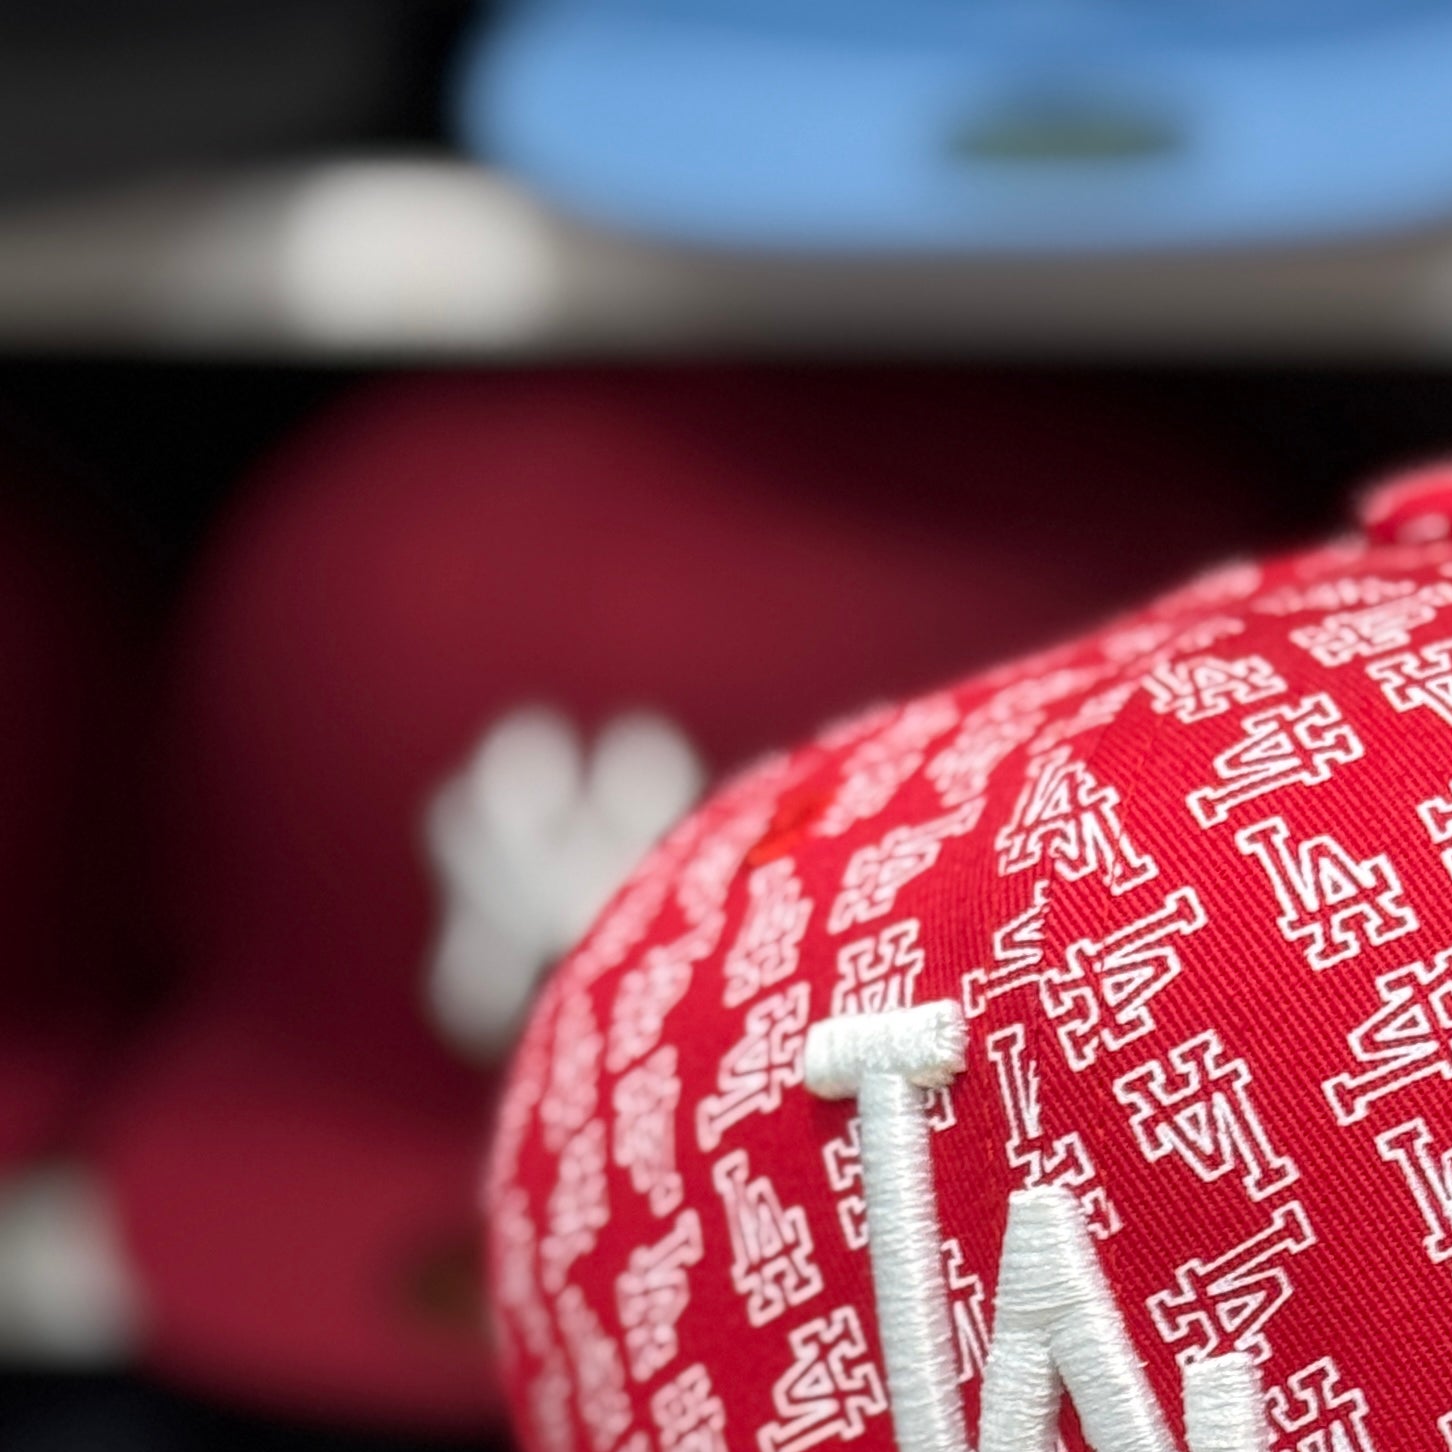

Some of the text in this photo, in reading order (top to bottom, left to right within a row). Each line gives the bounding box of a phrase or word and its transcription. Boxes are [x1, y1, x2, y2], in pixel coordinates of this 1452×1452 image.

[1187, 693, 1364, 828] LA
[1235, 817, 1419, 970] LA
[1039, 887, 1207, 1071] LA
[1113, 1029, 1301, 1202] LA
[712, 1148, 824, 1327] LA
[1146, 1201, 1317, 1366] LA
